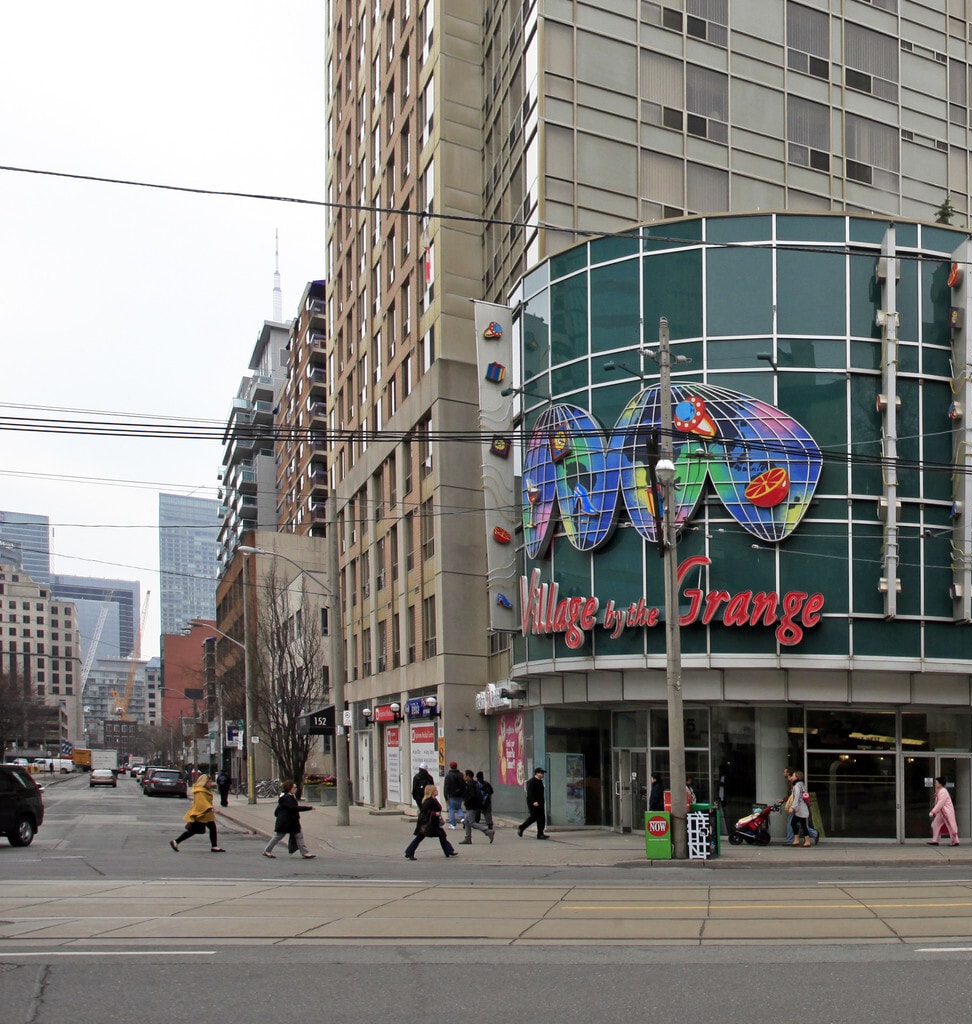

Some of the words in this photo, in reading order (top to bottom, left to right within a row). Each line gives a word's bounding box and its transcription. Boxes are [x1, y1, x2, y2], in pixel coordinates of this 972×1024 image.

[519, 568, 599, 649] Village
[603, 600, 626, 639] by
[627, 597, 660, 627] the
[677, 556, 825, 646] Grange
[314, 717, 327, 725] 152
[649, 820, 666, 832] NOW
